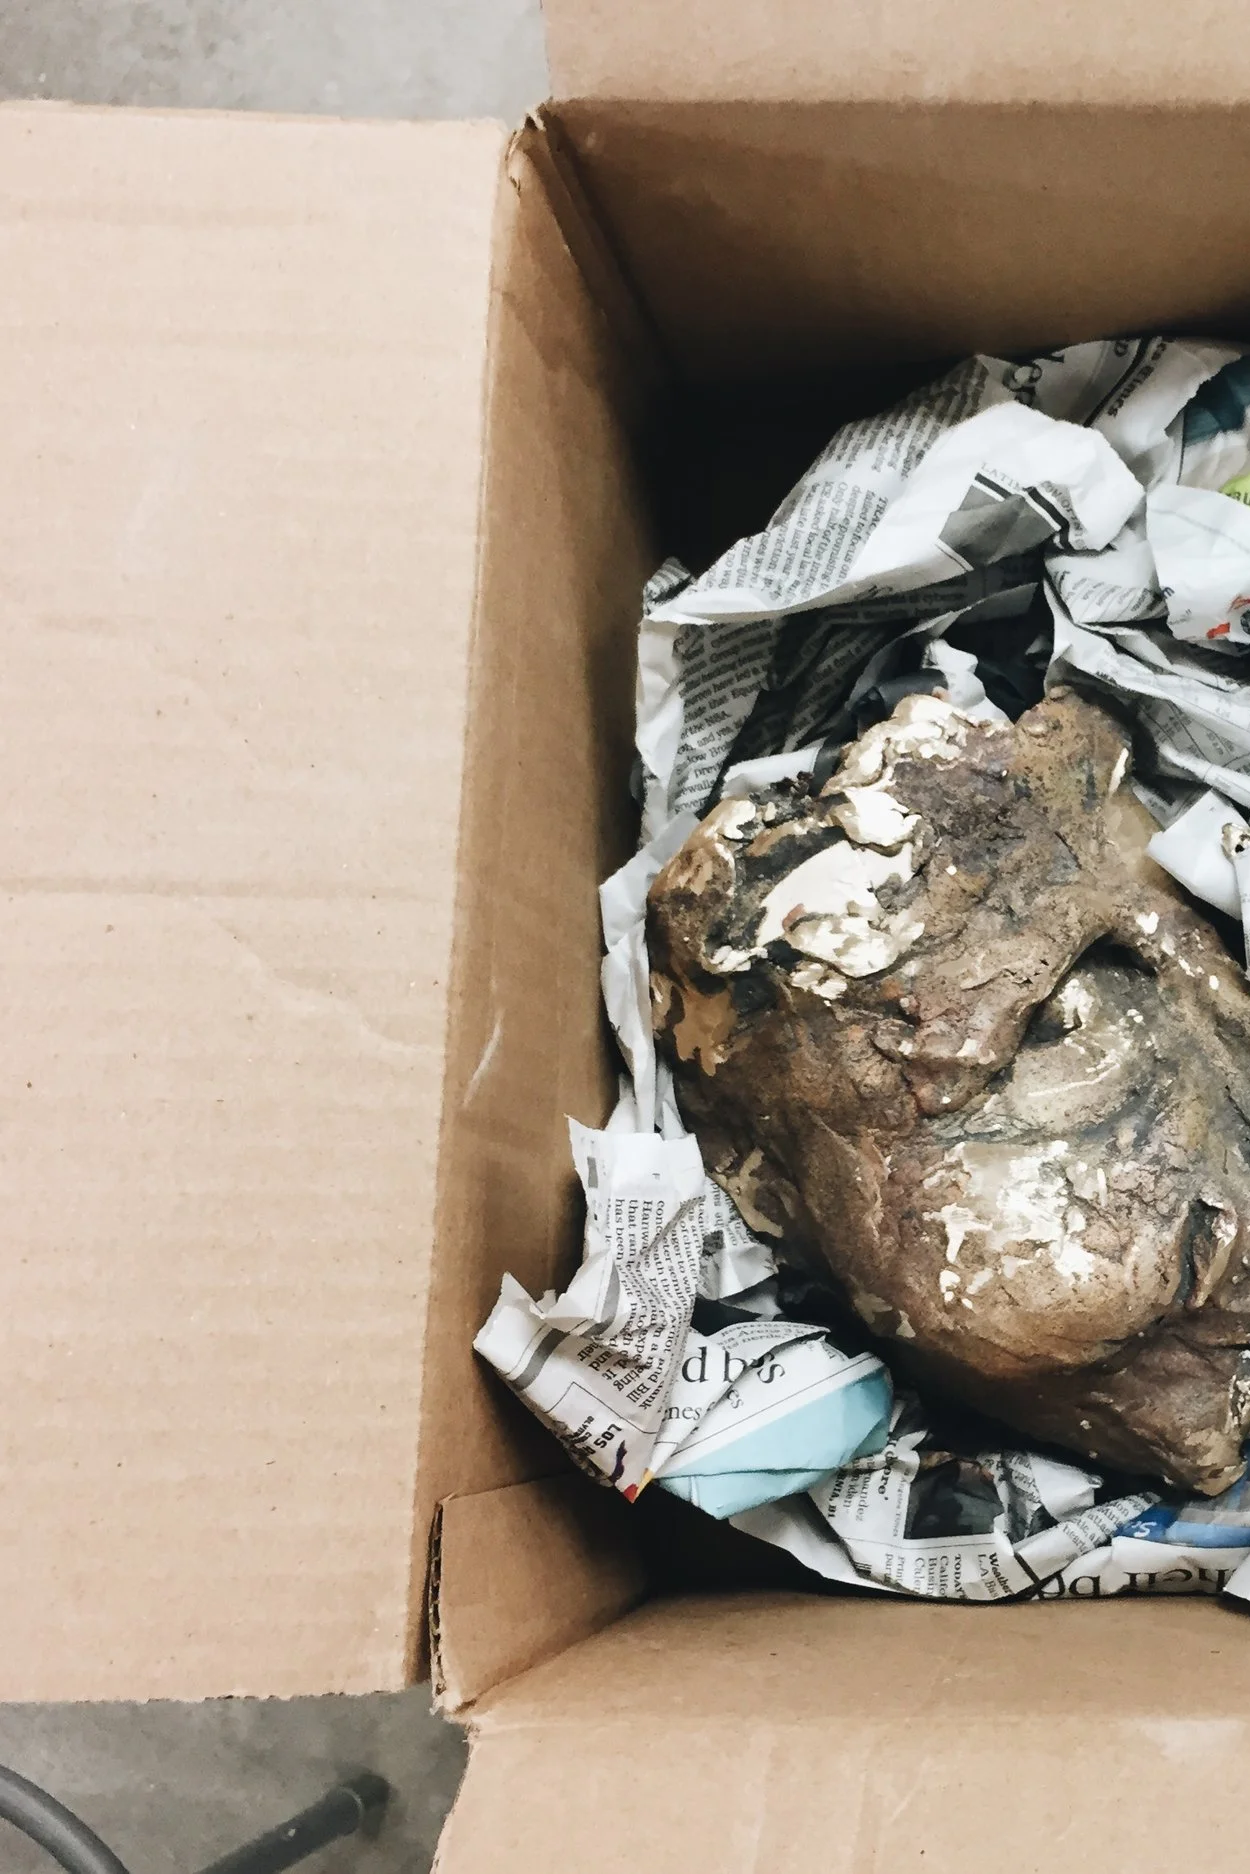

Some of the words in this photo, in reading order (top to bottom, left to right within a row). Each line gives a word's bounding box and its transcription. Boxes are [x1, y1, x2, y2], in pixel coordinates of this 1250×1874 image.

[815, 542, 828, 560] the
[821, 523, 847, 582] promising
[844, 533, 862, 563] focus
[614, 1199, 626, 1223] has
[627, 1199, 639, 1229] that
[614, 1227, 626, 1260] been
[627, 1233, 637, 1256] ran
[626, 1383, 649, 1402] Bill
[594, 1424, 622, 1448] LOS
